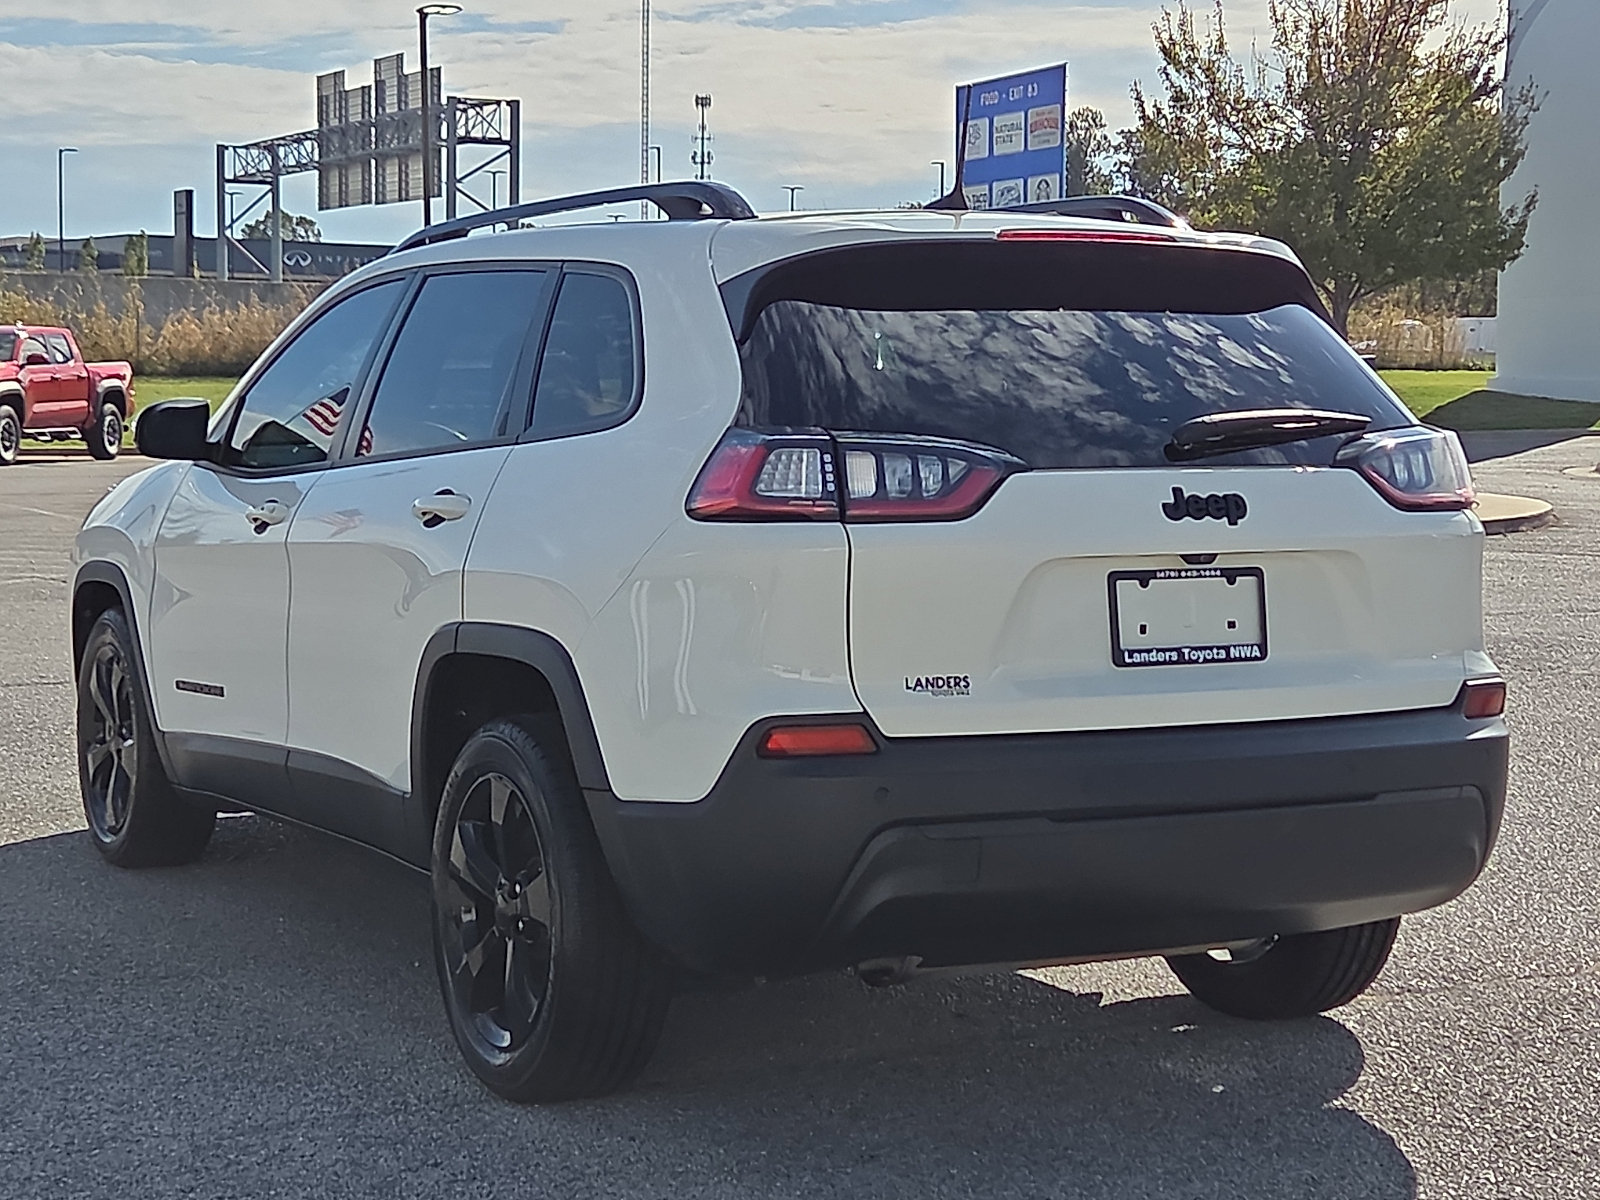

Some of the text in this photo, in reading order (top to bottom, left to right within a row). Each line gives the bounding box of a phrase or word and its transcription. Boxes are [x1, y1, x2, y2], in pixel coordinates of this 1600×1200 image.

[980, 91, 999, 107] FOOD
[1008, 85, 1024, 101] EXIT
[1161, 486, 1248, 526] Jeep
[1124, 645, 1262, 664] Landers Toyota NWA
[904, 675, 971, 692] LANDERS
